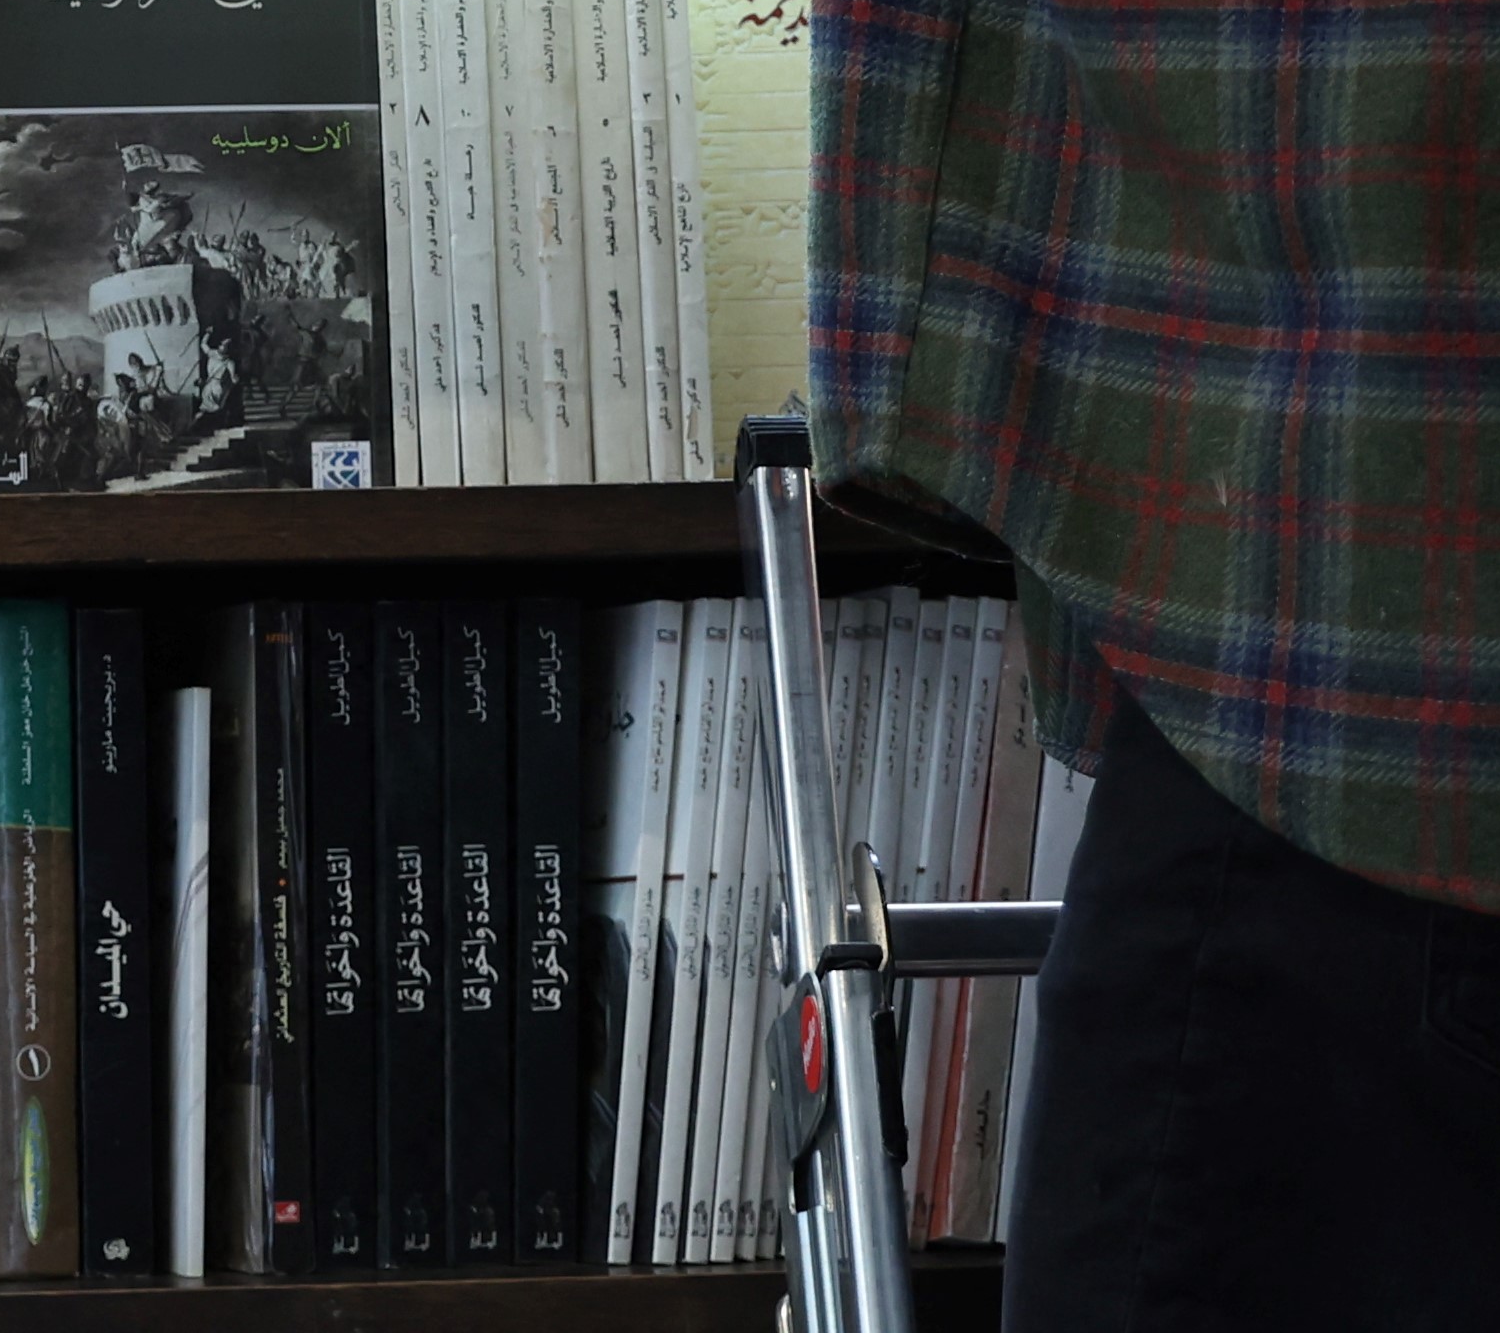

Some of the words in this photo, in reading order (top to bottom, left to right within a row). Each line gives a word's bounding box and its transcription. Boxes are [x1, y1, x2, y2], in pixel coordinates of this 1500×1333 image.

[293, 120, 351, 152] ألان
[326, 627, 351, 677] كميل
[327, 664, 351, 726] الطويل
[325, 847, 353, 928] القاعدة
[101, 899, 132, 937] حي
[272, 893, 287, 940] فلسفة
[94, 937, 129, 1019] الميدان
[273, 941, 292, 988] التاريخ
